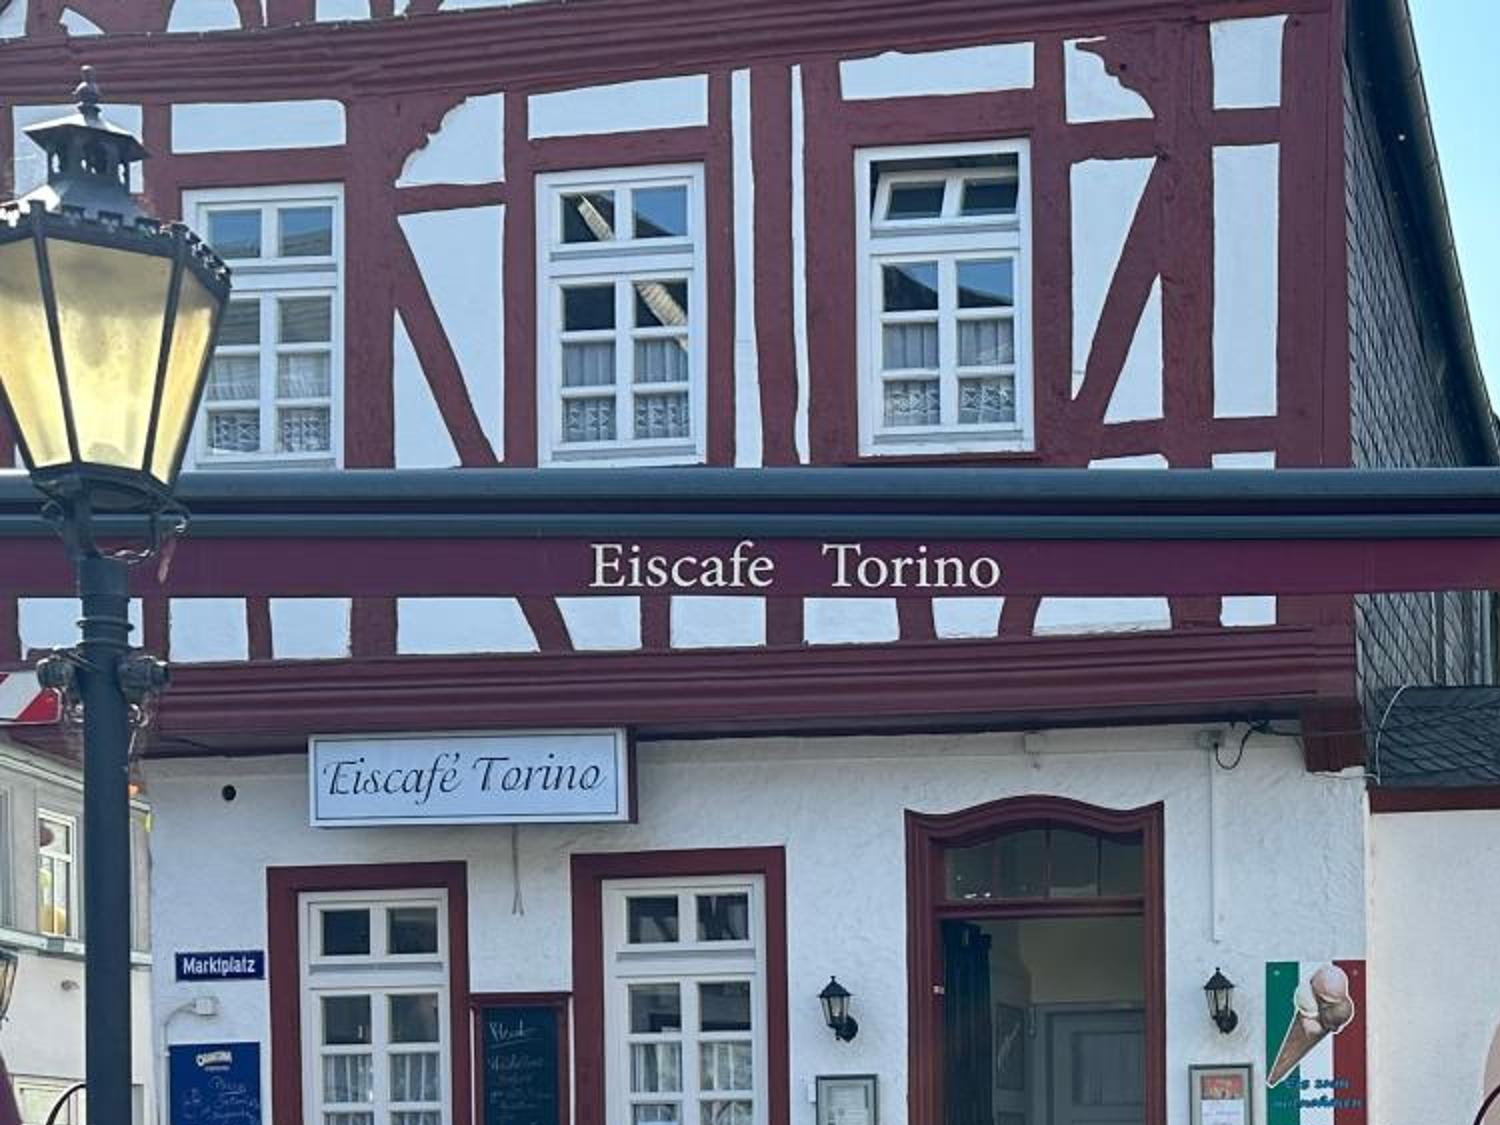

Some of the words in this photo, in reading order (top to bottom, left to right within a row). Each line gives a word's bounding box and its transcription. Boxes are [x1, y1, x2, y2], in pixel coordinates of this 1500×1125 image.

[588, 540, 775, 588] Eiscafe
[821, 543, 1001, 589] Torino
[323, 751, 465, 806] Eiscafé
[472, 752, 608, 793] Torino
[183, 955, 256, 977] Marktplatz
